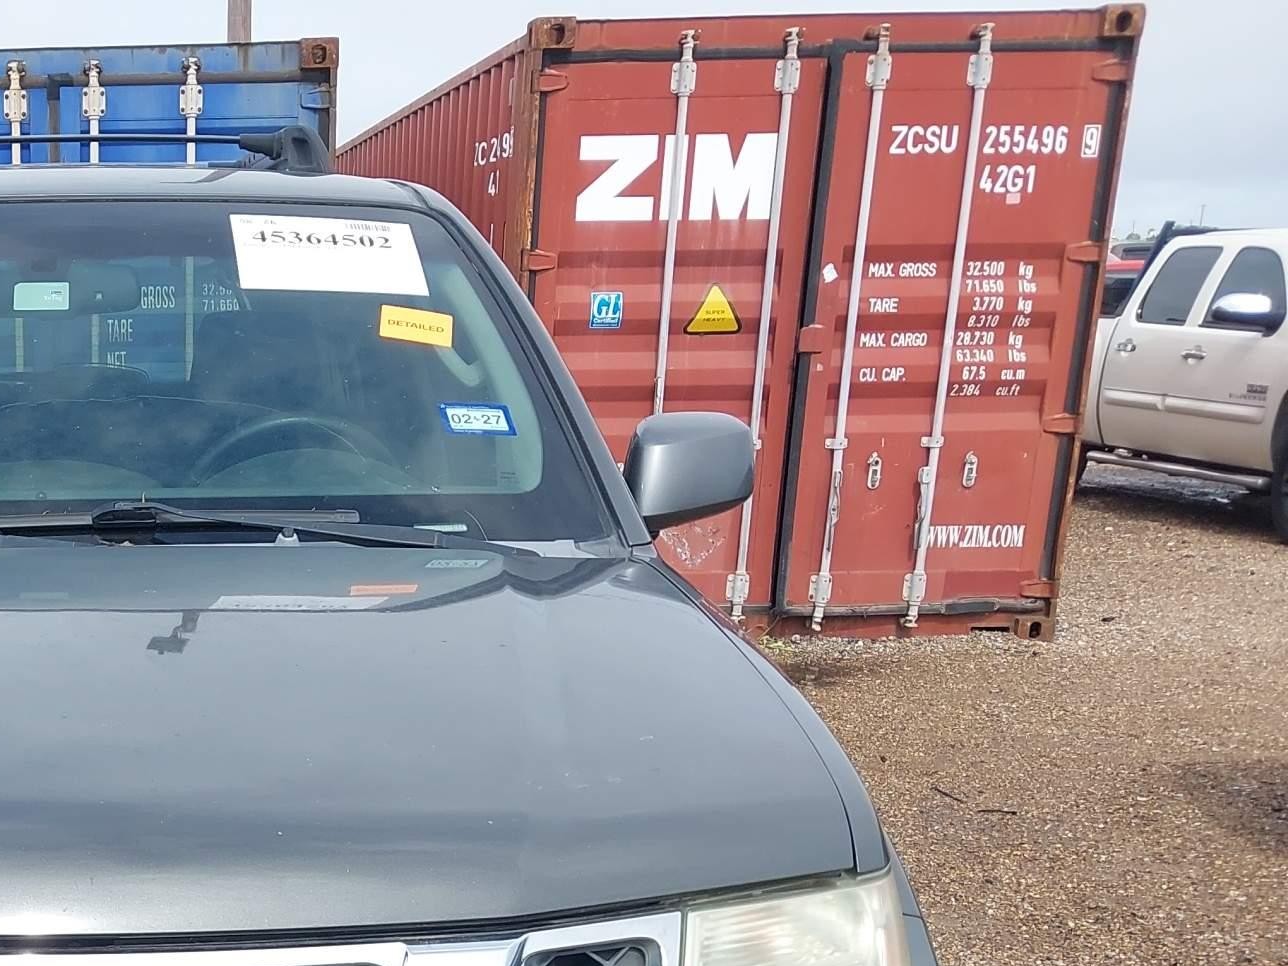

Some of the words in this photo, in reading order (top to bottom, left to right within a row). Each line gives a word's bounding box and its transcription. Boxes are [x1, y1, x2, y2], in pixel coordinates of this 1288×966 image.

[889, 124, 960, 155] ZCSU
[982, 124, 1070, 155] 255496
[1084, 127, 1099, 154] 9
[575, 132, 779, 222] ZIM
[979, 164, 1037, 193] 42G1
[252, 230, 392, 249] 45364502
[868, 262, 895, 277] MAX.
[899, 262, 937, 277] GROSS
[966, 261, 1005, 276] 32.500
[1018, 262, 1034, 279] kg
[965, 280, 1004, 293] 71.650
[1018, 280, 1037, 293] lbs
[140, 286, 175, 309] GROSS
[868, 297, 899, 313] TARE
[972, 296, 1004, 311] 3.770
[1017, 297, 1033, 314] kg
[387, 319, 445, 333] DETAILED
[967, 315, 1000, 327] 8.310
[1012, 315, 1031, 327] lbs
[107, 319, 133, 343] TARE
[859, 332, 886, 347] MAX.
[890, 332, 928, 347] CARGO
[956, 331, 995, 346] 28.730
[1008, 331, 1023, 349] kg
[956, 349, 994, 362] 63.340
[1008, 349, 1027, 362] lbs
[859, 367, 878, 382] CU.
[882, 367, 906, 382] CAP.
[962, 366, 986, 380] 67.5
[1000, 367, 1026, 380] cu.m
[950, 384, 981, 396] 2.384
[995, 384, 1021, 396] cu.ft
[926, 524, 1026, 549] WWW.ZIM.COM
